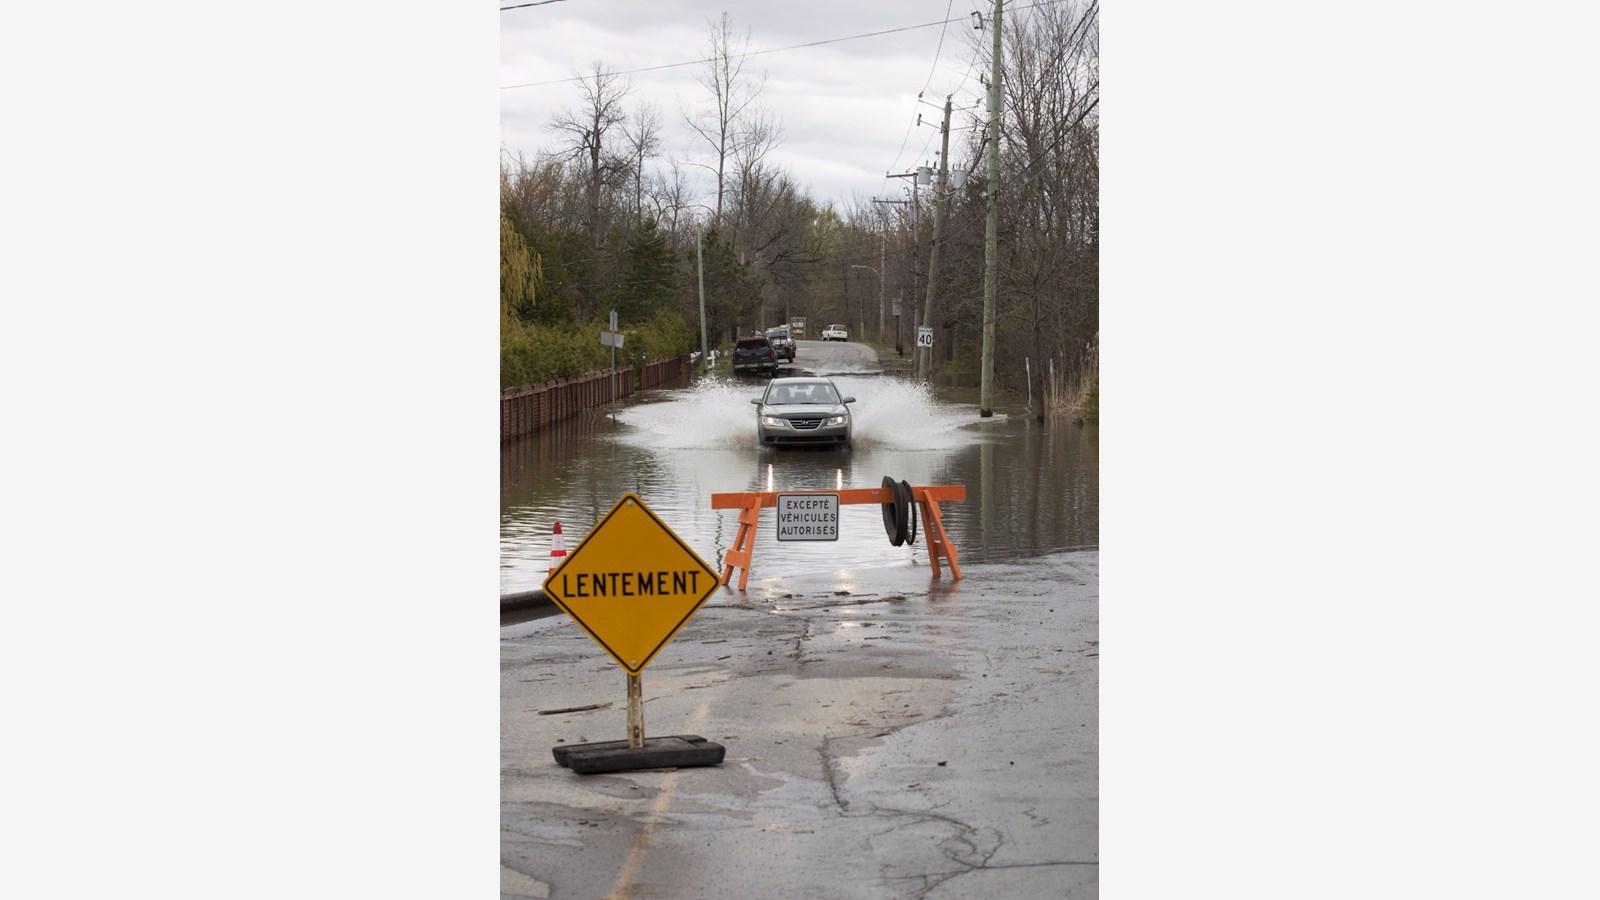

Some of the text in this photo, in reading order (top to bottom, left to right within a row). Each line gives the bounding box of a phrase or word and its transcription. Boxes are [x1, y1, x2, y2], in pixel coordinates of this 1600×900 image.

[919, 334, 932, 345] 40
[787, 499, 830, 510] EXCEPTÉ
[781, 512, 836, 522] VÉHICULES
[780, 524, 836, 535] AUTORISÉS
[563, 570, 700, 597] LENTEMENT
